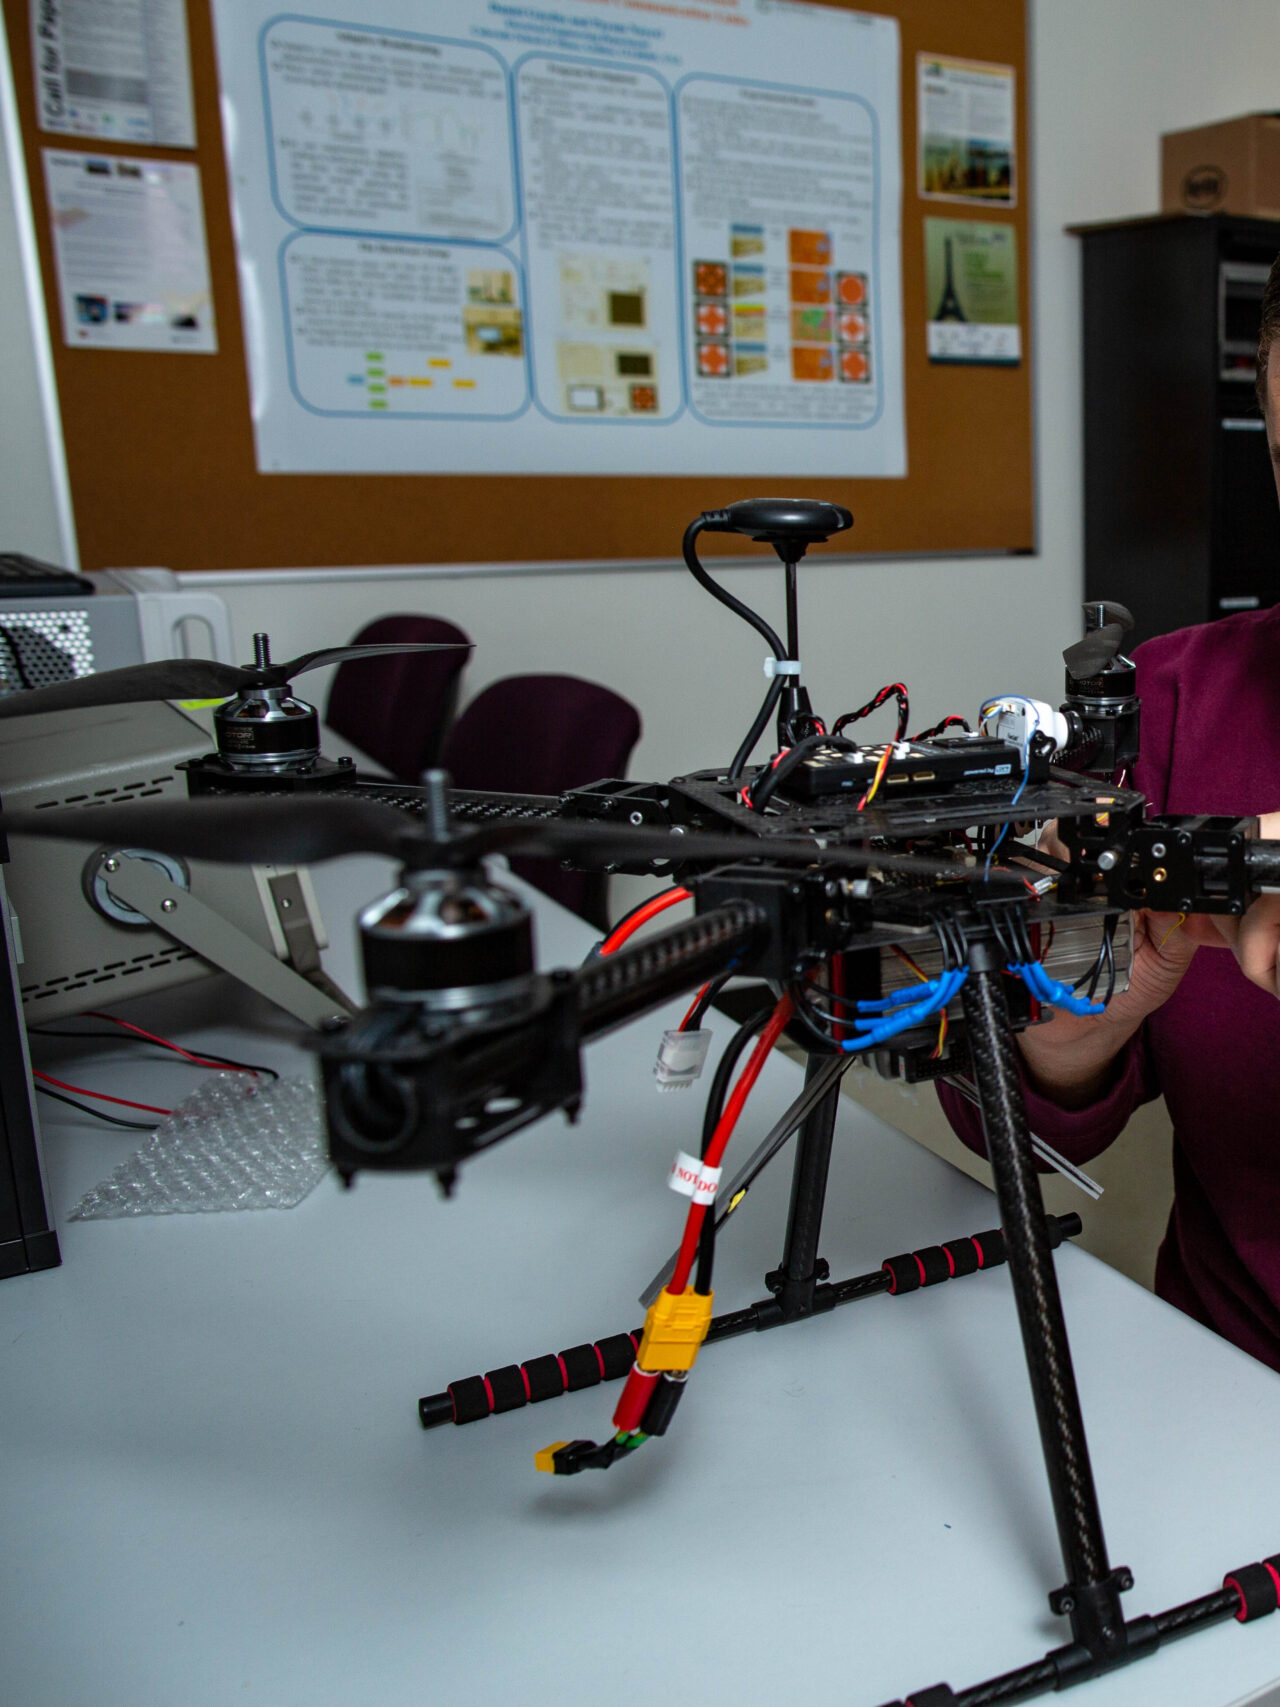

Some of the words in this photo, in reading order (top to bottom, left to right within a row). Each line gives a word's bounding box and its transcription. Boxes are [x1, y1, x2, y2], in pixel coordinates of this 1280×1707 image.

[42, 43, 61, 75] for
[44, 76, 65, 118] Call
[697, 1180, 719, 1193] DO
